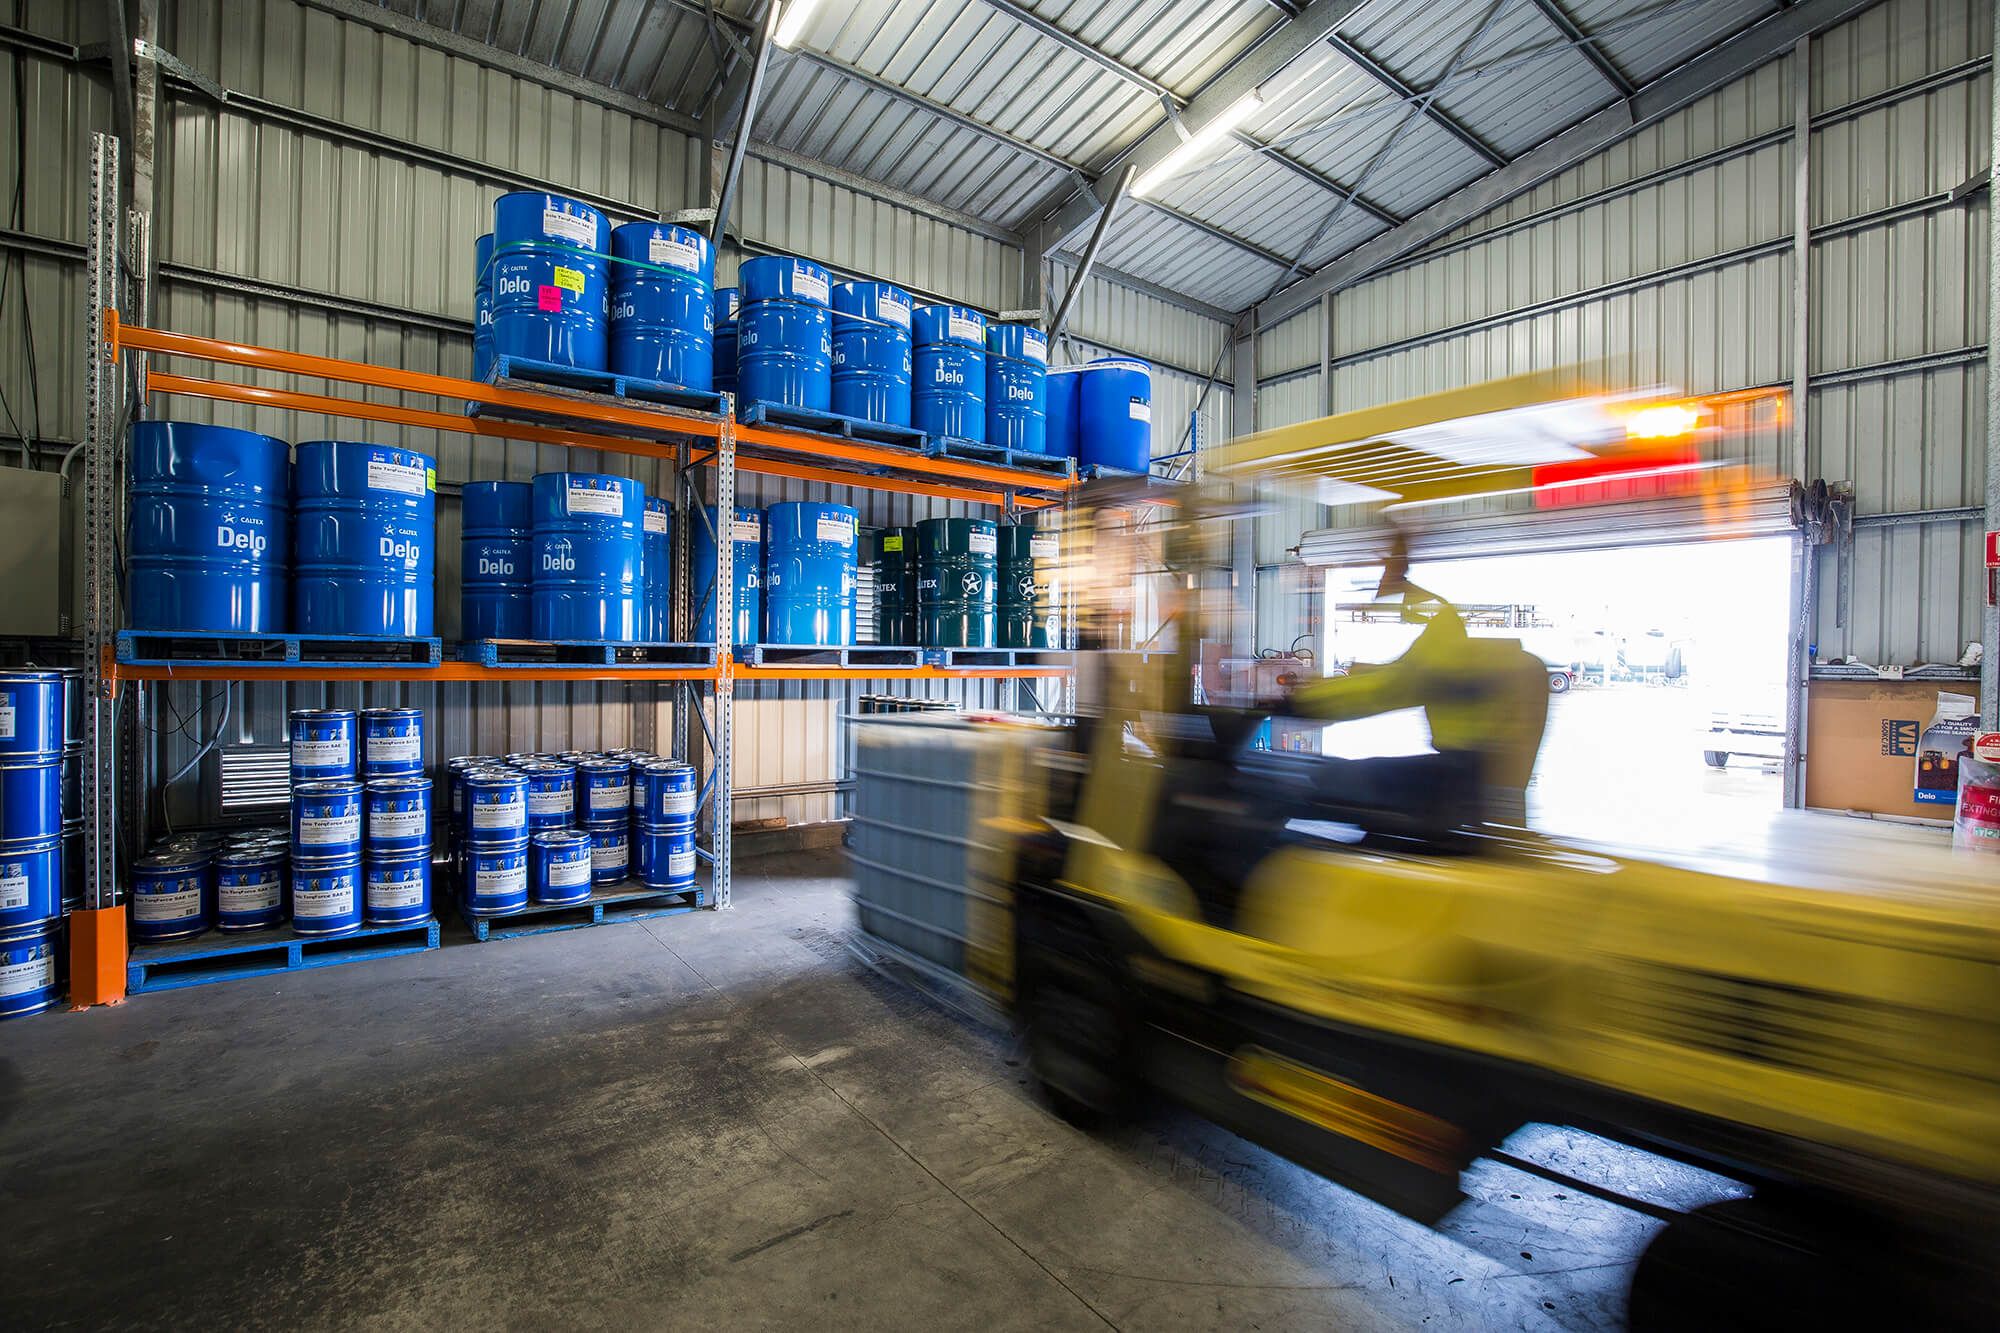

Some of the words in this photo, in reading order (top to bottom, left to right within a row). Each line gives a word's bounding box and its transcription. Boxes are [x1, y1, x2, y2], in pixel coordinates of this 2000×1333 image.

[499, 275, 531, 296] Delo
[611, 301, 635, 321] Delo
[935, 368, 964, 385] Delo
[1008, 385, 1034, 401] Delo
[240, 516, 264, 526] CALTEX
[217, 526, 266, 551] Delo
[380, 537, 420, 560] Delo
[479, 558, 514, 575] Delo
[542, 553, 576, 571] Delo
[1898, 724, 1916, 755] VIP
[1918, 791, 1936, 800] Delo
[1961, 803, 2000, 817] EXTING
